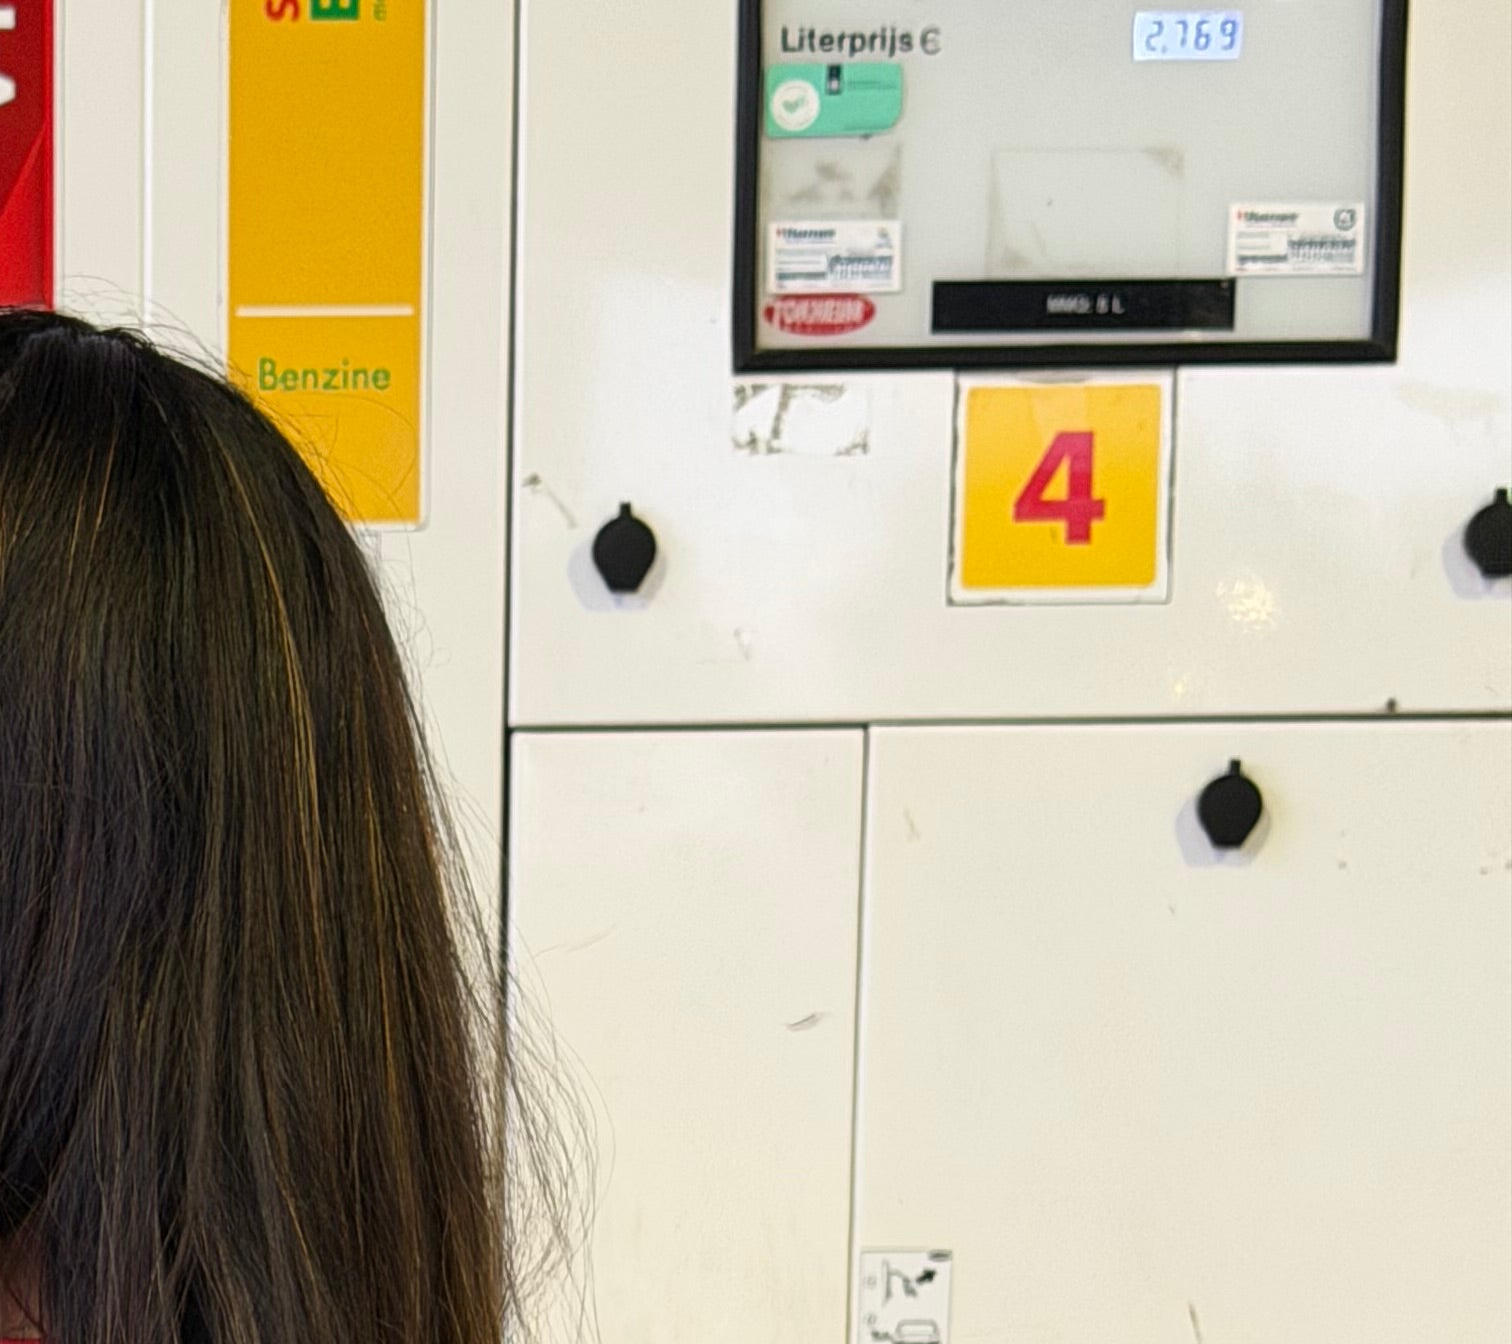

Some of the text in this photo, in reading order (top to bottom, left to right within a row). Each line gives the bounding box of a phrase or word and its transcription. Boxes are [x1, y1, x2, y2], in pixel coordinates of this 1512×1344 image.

[780, 24, 914, 58] Literprijs
[258, 357, 391, 391] Benzine
[1011, 429, 1106, 547] 4
